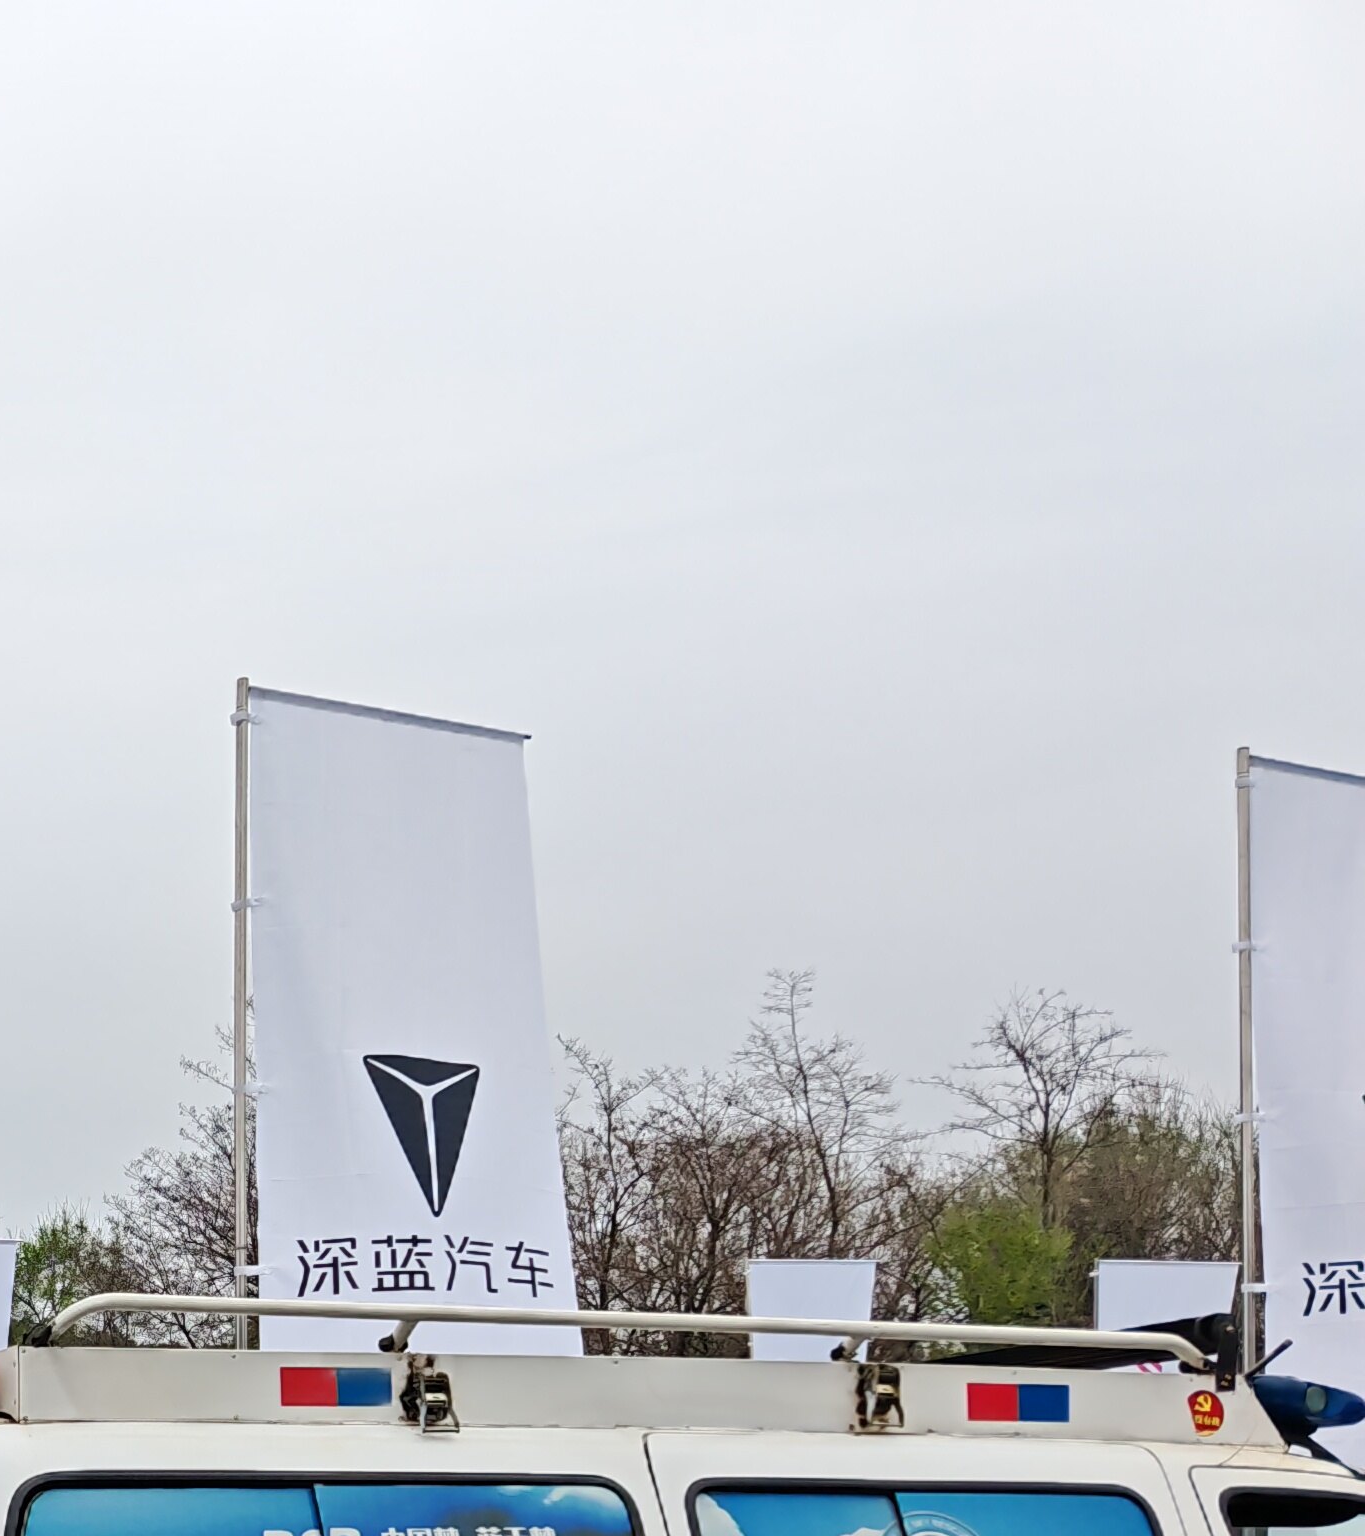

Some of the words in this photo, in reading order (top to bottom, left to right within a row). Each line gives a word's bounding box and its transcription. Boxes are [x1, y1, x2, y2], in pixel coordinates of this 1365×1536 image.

[297, 1235, 555, 1299] 深蓝汽车
[1302, 1262, 1365, 1316] 深
